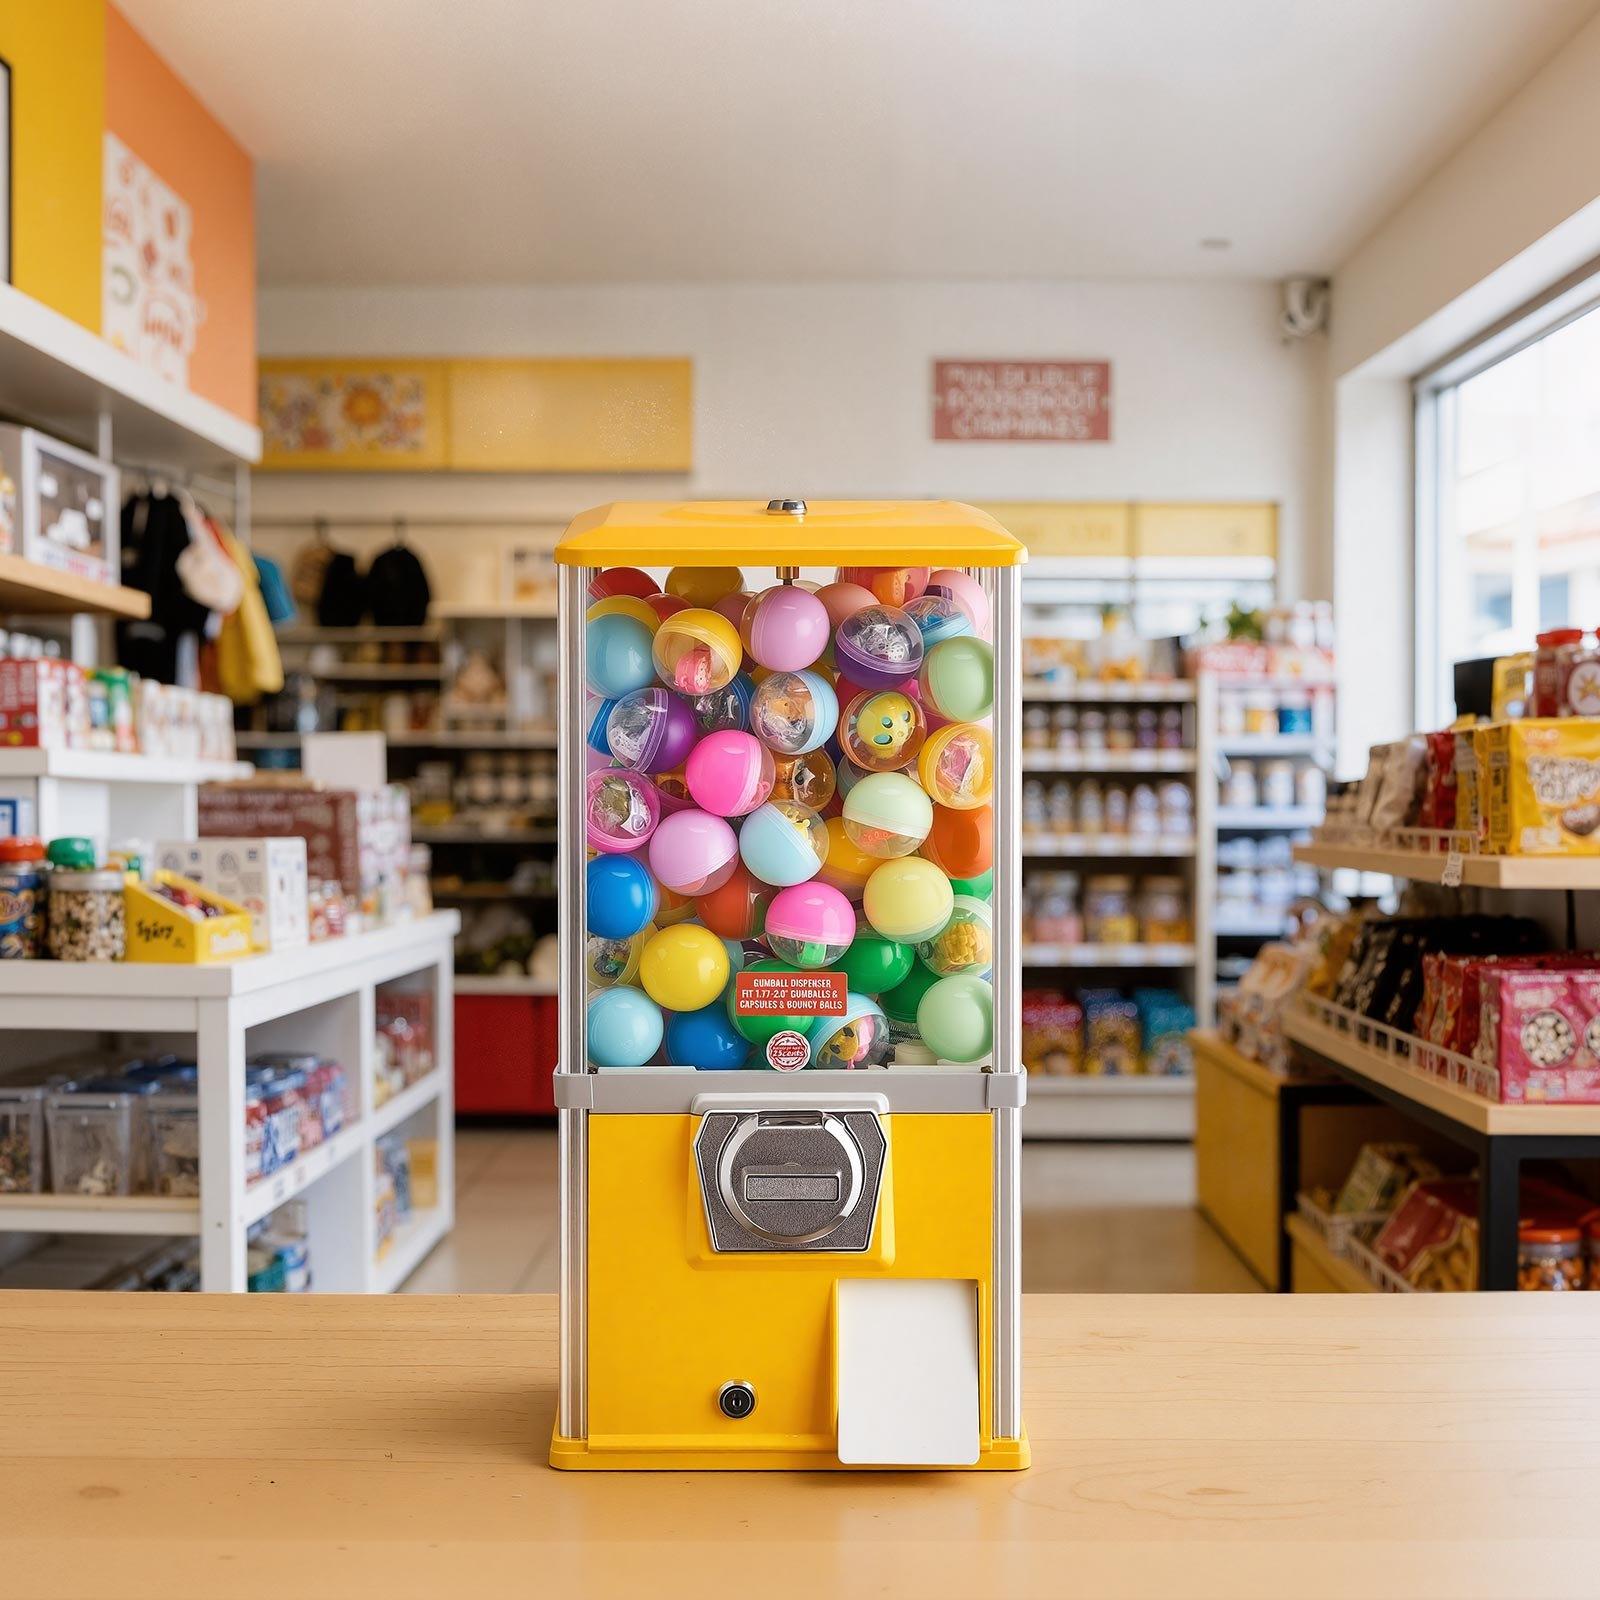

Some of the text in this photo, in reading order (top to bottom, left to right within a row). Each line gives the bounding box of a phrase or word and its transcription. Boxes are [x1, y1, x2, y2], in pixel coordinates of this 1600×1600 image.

[753, 979, 831, 988] GUMBALL DISPENSER
[741, 990, 753, 999] FIT
[790, 990, 831, 999] GUMBALLS
[832, 990, 838, 999] &
[739, 1000, 843, 1009] CAPSULES & BOUNCY BALLS
